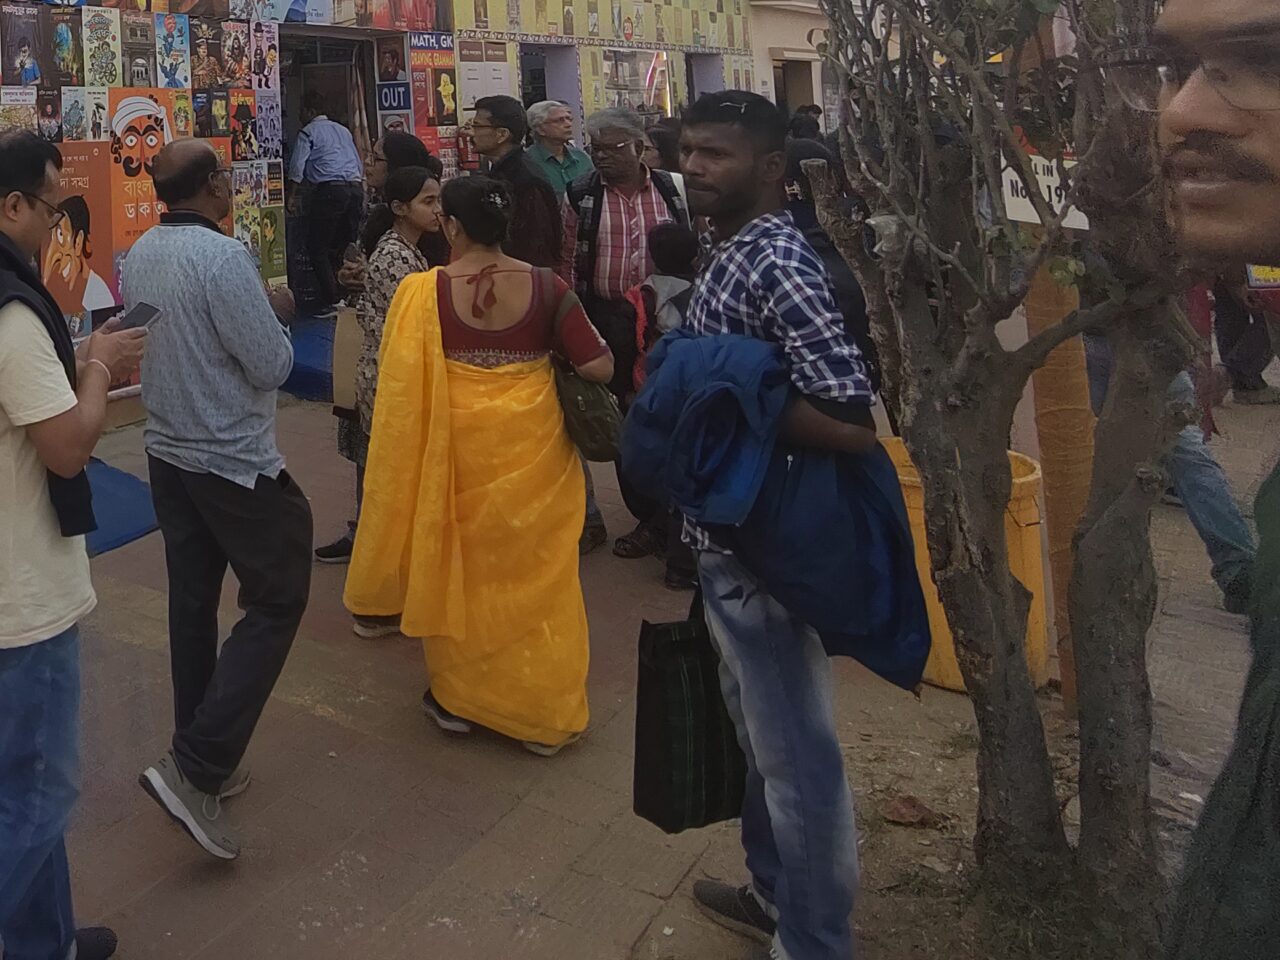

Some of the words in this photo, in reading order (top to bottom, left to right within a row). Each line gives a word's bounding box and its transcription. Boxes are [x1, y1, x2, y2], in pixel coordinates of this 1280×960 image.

[411, 34, 438, 49] MATH,
[440, 35, 454, 48] GK
[382, 87, 405, 107] OUT
[71, 176, 89, 189] সমগ্র
